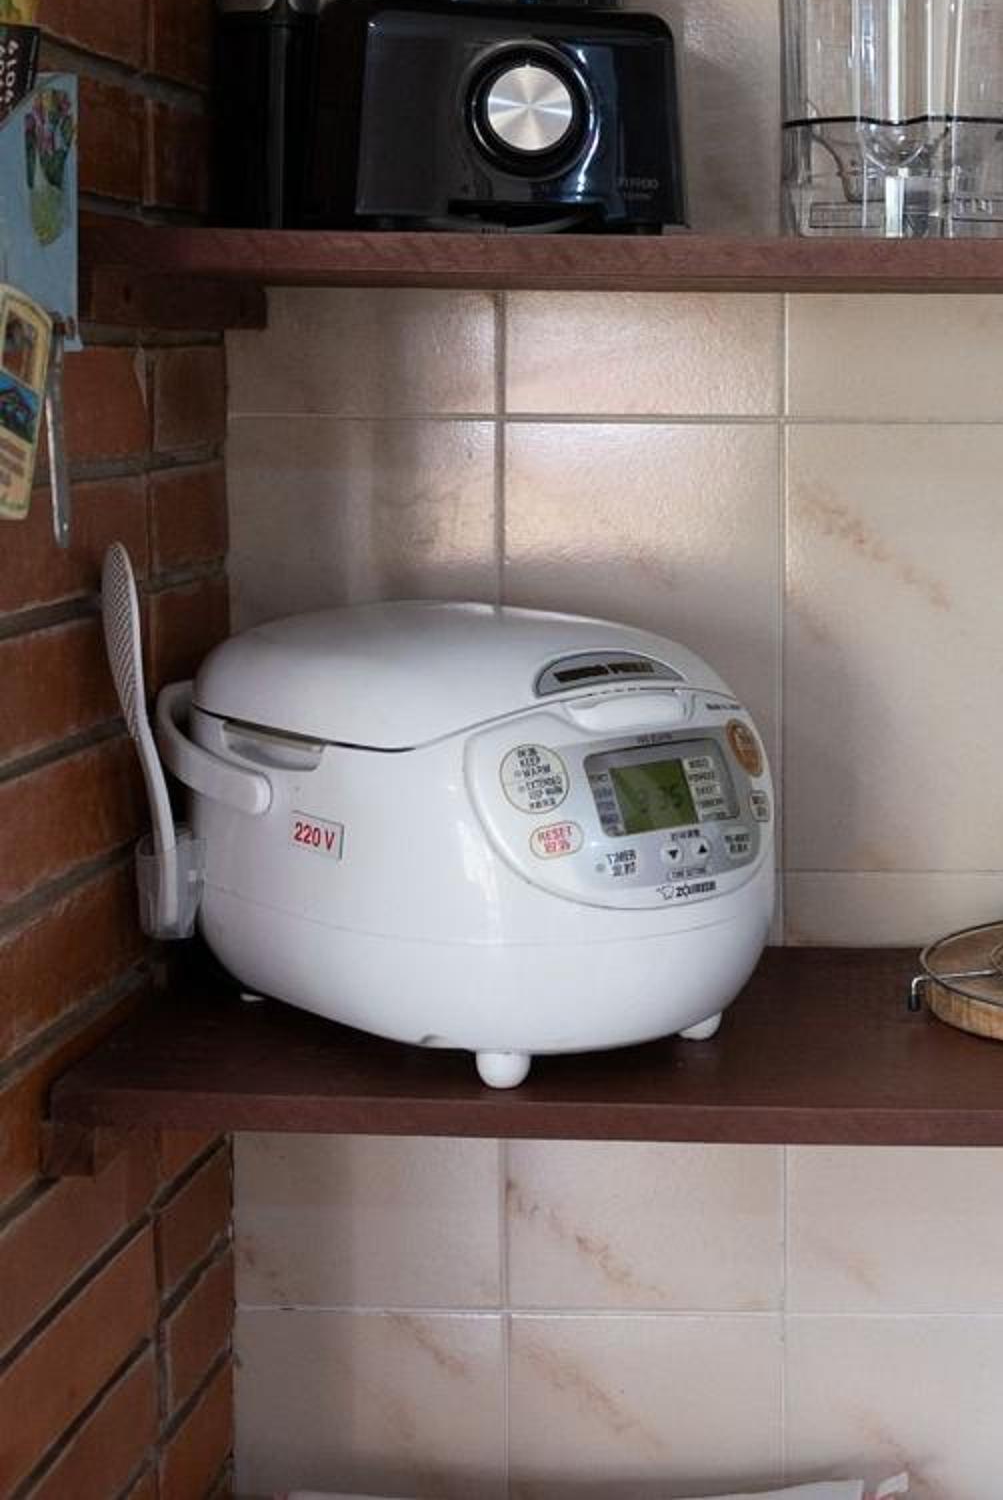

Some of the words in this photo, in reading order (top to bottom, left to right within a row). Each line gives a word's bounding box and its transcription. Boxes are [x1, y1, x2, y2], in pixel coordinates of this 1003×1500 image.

[522, 763, 551, 778] WARM
[294, 821, 321, 847] 220
[325, 831, 335, 850] V
[537, 825, 573, 843] RESET
[605, 849, 637, 865] TIMER
